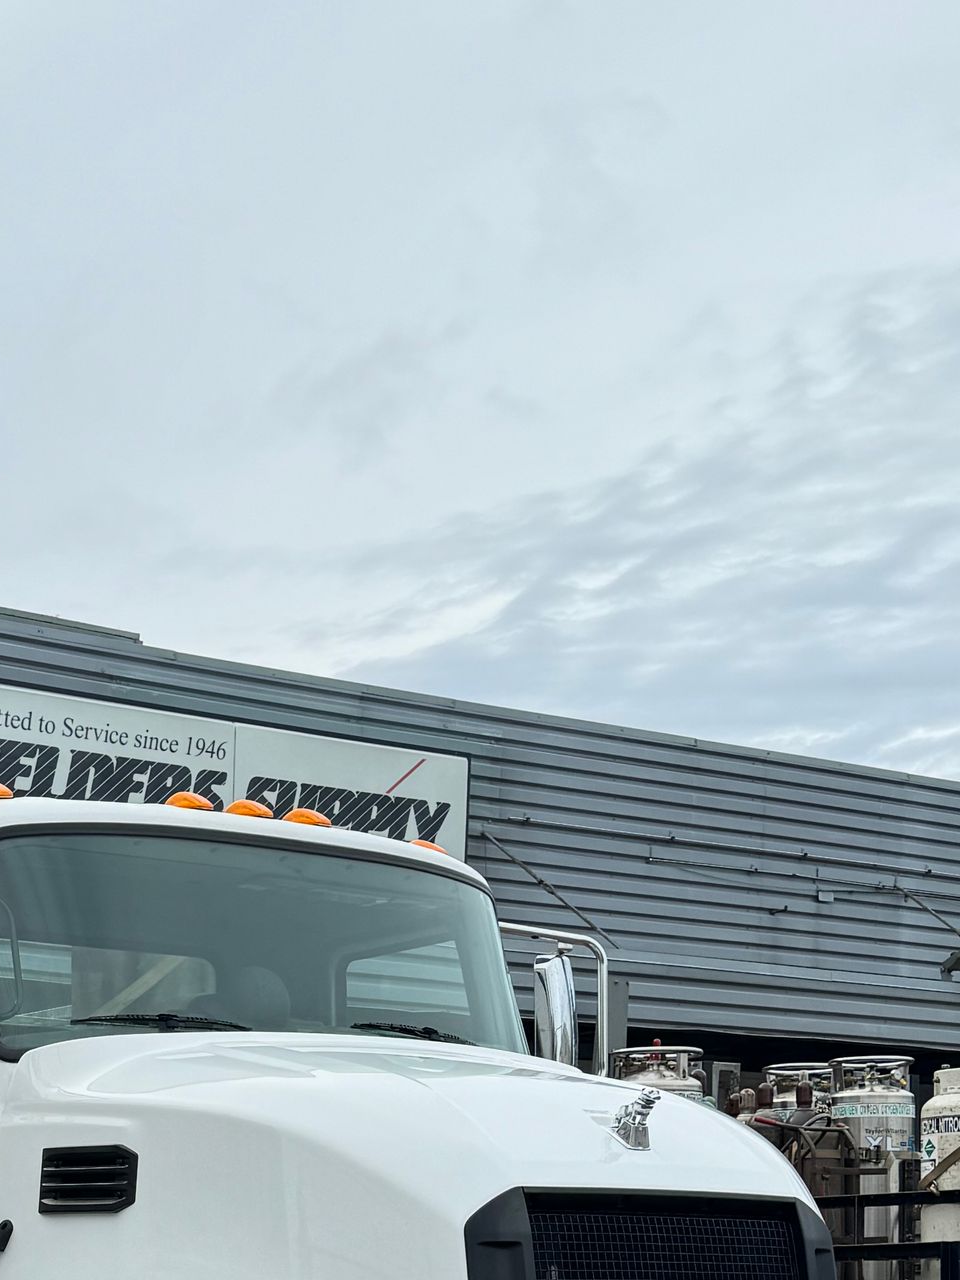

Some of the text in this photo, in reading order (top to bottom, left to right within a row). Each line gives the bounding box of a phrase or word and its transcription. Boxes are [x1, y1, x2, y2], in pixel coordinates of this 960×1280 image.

[38, 716, 56, 735] to
[62, 716, 128, 746] Service
[134, 729, 179, 753] since
[186, 736, 227, 760] 1946
[246, 776, 451, 842] SUPPLY
